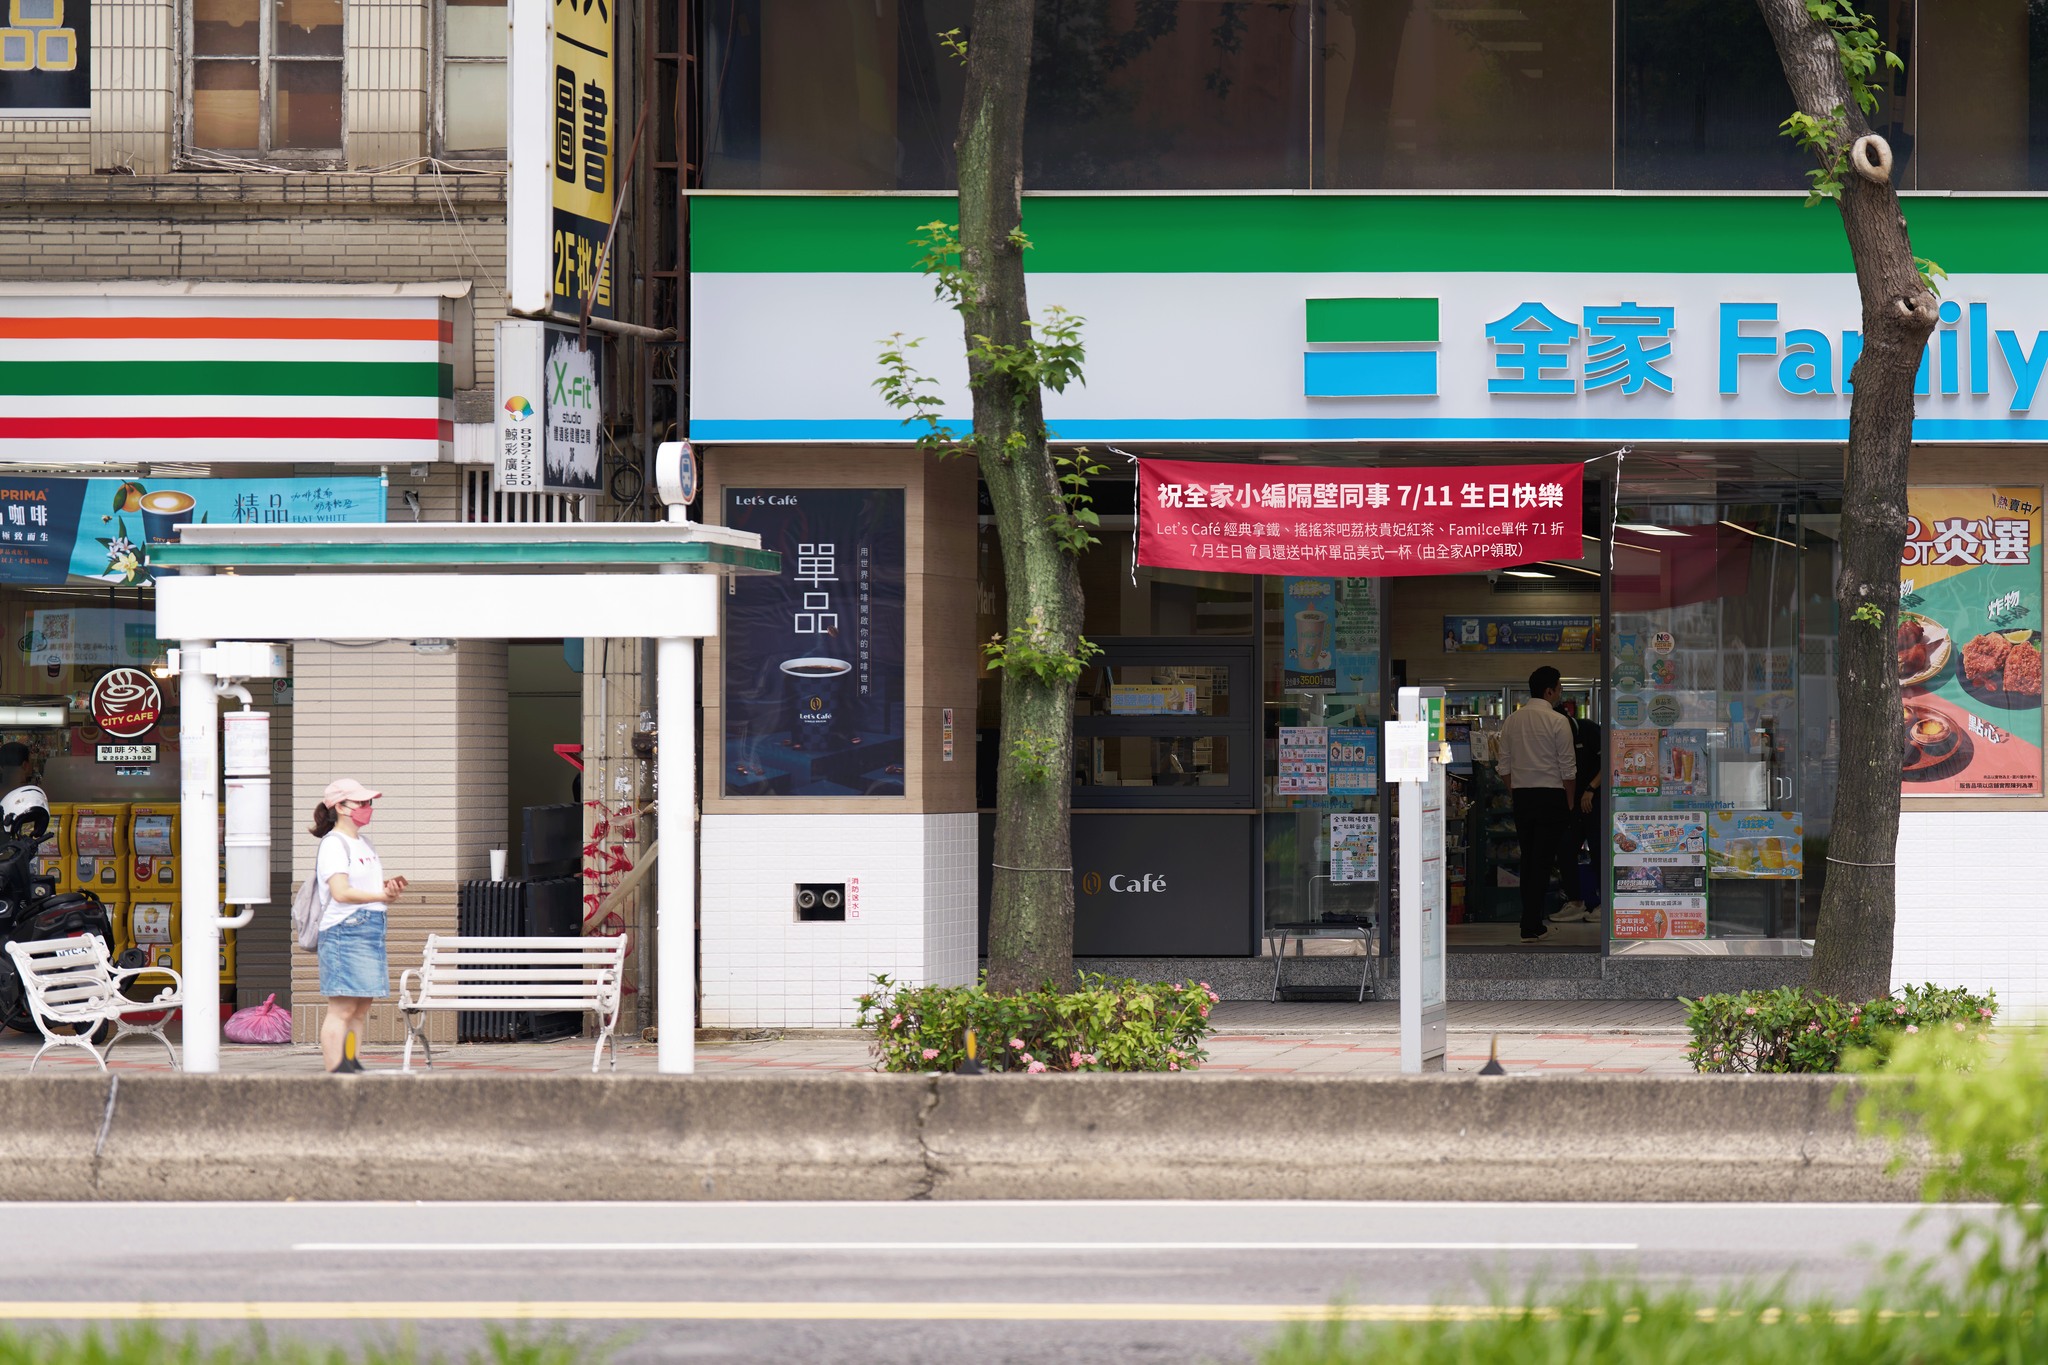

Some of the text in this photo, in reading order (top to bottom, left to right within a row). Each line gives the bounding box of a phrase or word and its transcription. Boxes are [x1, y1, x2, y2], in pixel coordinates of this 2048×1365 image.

[556, 64, 608, 193] 圖書
[1485, 302, 1676, 395] 全家
[505, 428, 518, 486] 鯨彩廣告
[232, 493, 289, 523] 精品
[768, 494, 798, 506] Café
[1157, 482, 1564, 510] 祝全家小編隔壁同事 7/11 生日快樂
[1996, 495, 2033, 514] 熱賣中
[316, 514, 348, 522] WHITE
[1191, 522, 1221, 536] Café
[1532, 523, 1547, 535] 71
[1550, 521, 1565, 536] 折
[1190, 544, 1198, 556] 7
[1931, 516, 2029, 564] 炎選
[794, 543, 839, 634] 單品
[1987, 590, 2020, 619] 炸物
[101, 711, 154, 727] CITY CAFE
[1968, 713, 2000, 744] 點心
[1687, 800, 1735, 809] FamilyMart
[1109, 873, 1167, 893] Café
